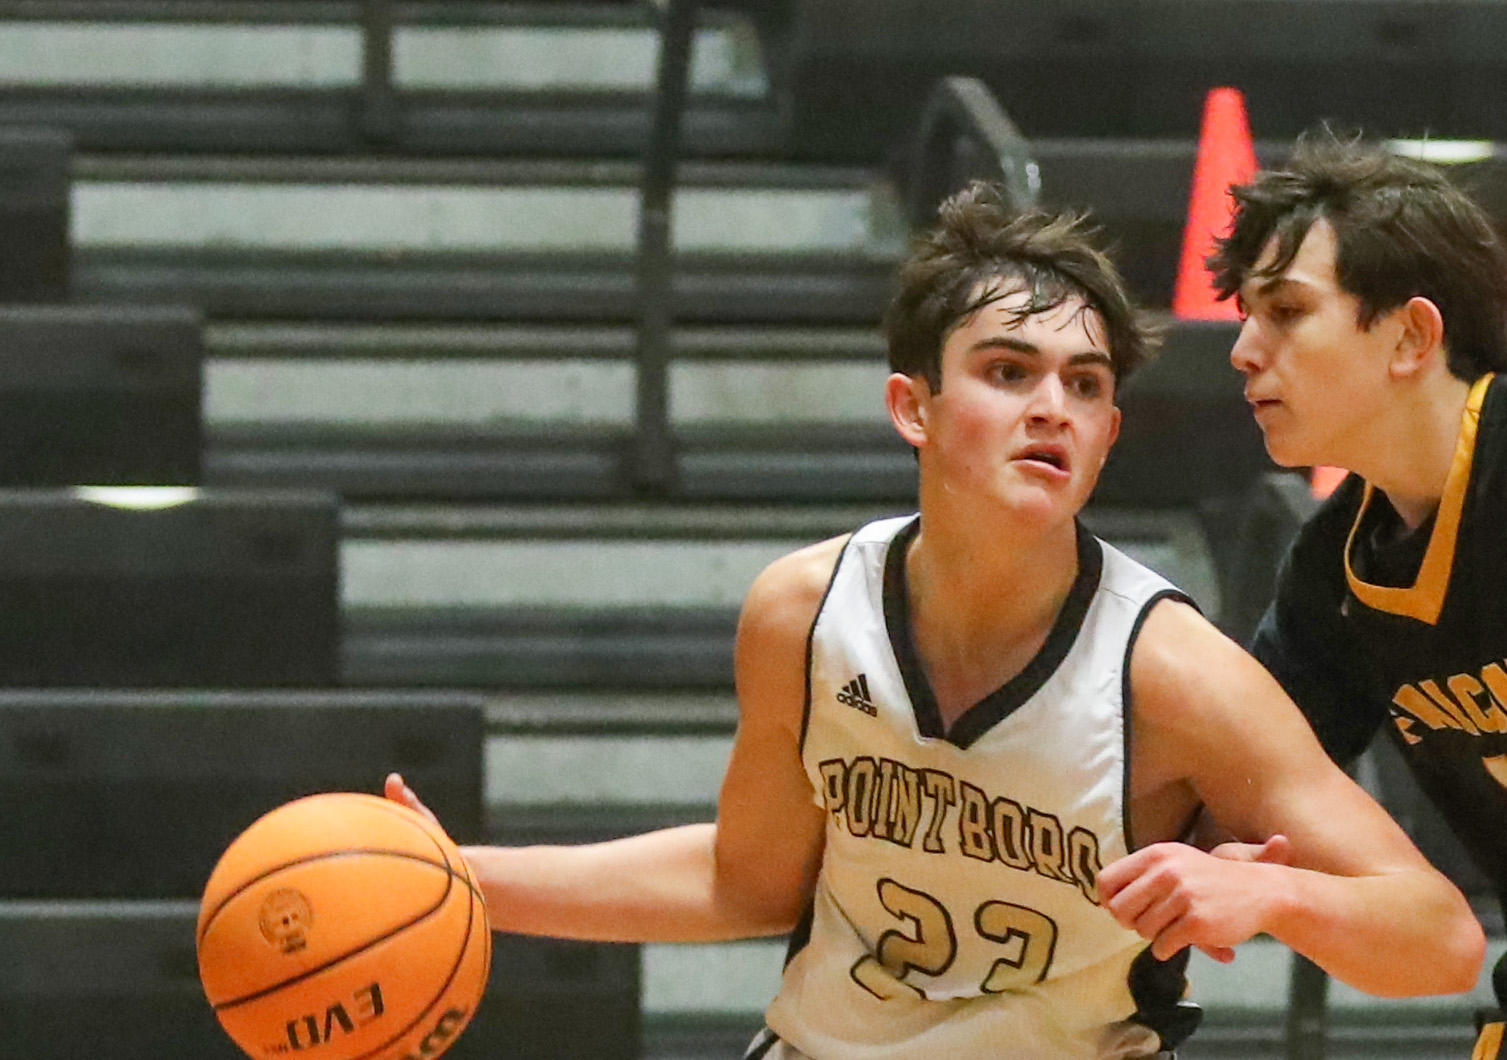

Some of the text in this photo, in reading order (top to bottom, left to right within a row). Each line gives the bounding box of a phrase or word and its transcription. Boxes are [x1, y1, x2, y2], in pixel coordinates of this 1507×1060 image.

[836, 692, 878, 718] adidas
[849, 877, 1058, 1001] 23
[285, 982, 385, 1051] EVO
